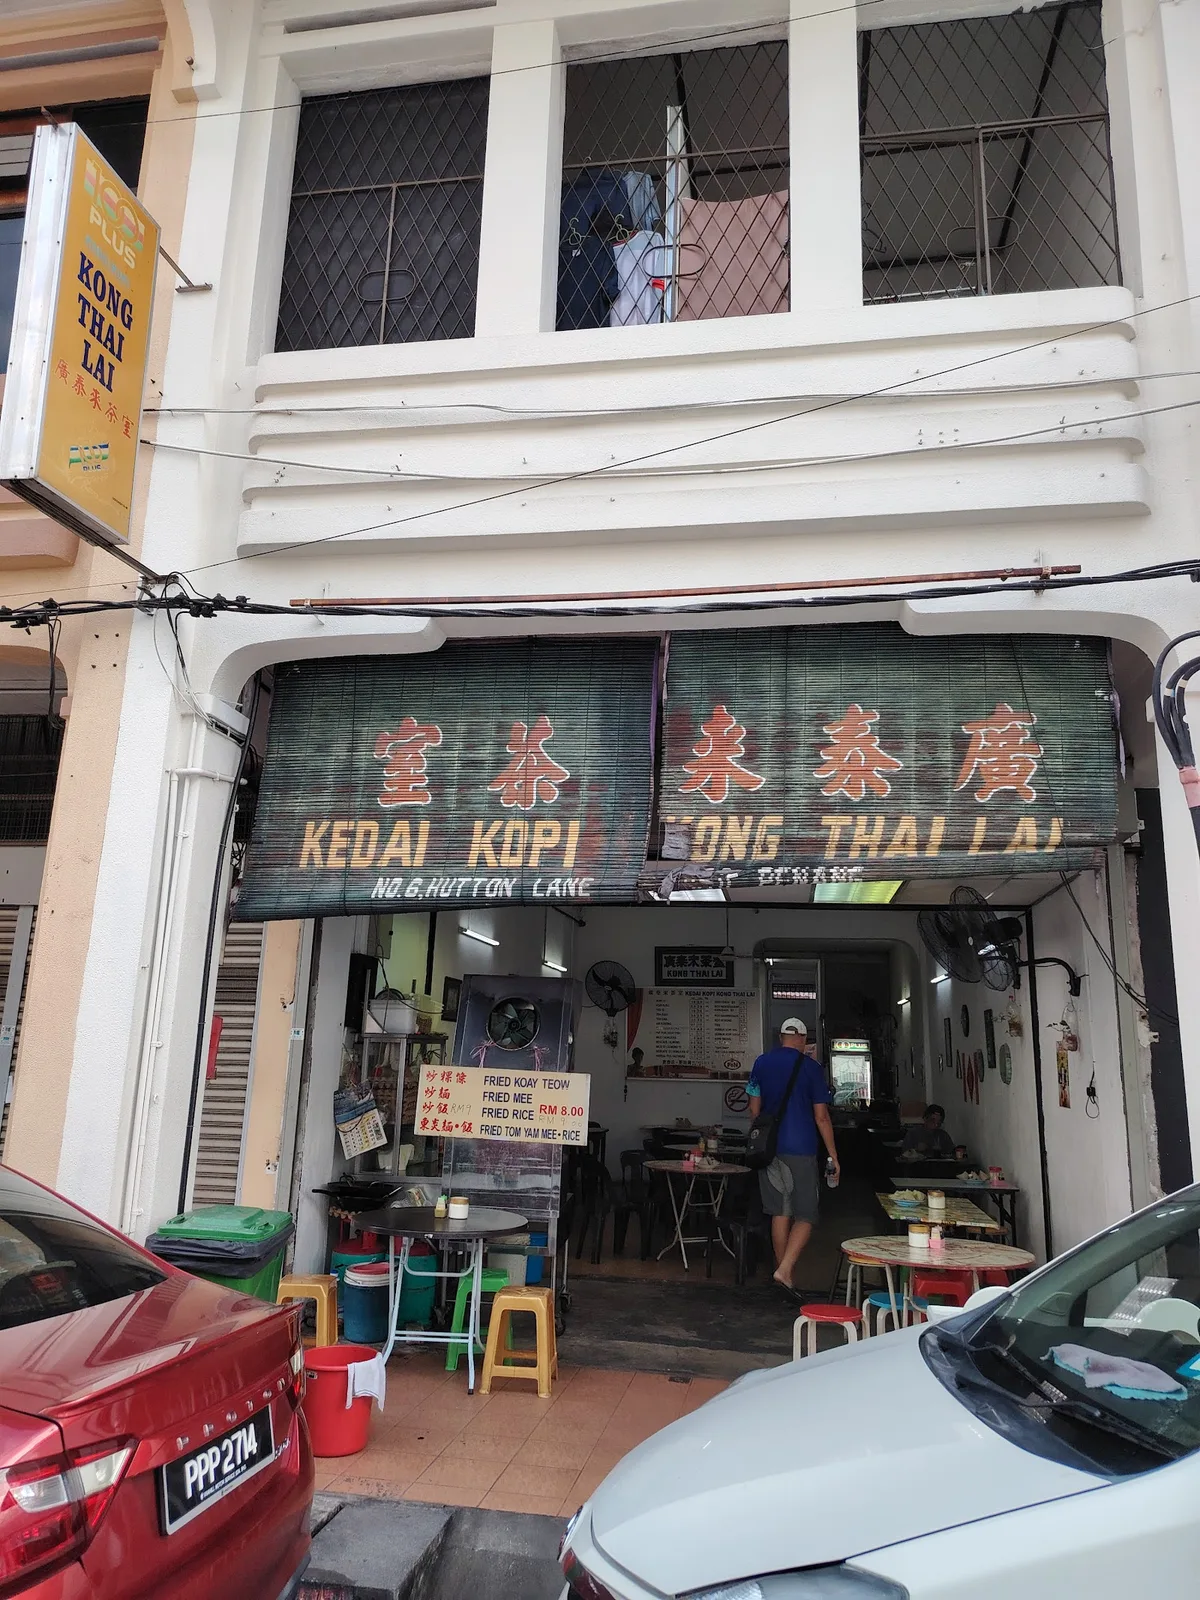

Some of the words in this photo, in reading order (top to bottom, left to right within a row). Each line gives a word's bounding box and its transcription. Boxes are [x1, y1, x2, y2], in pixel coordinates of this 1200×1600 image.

[89, 204, 136, 269] PLUS
[78, 251, 133, 331] KONG
[78, 293, 125, 363] THAI
[81, 339, 115, 393] LAI
[299, 819, 430, 868] KEDAI
[467, 819, 580, 868] KOPI
[660, 815, 784, 861] ONG
[821, 815, 945, 859] THAI
[967, 816, 1064, 855] LAI
[532, 877, 595, 898] LANE
[667, 970, 688, 978] KONG
[690, 970, 710, 978] THAI
[711, 970, 723, 978] LAI
[482, 1091, 510, 1103] FRIED
[513, 1093, 533, 1104] MEE
[483, 1075, 511, 1088] FRIED
[514, 1077, 538, 1089] KOAY
[542, 1078, 570, 1091] TEOW
[481, 1107, 510, 1119] FRIED
[512, 1109, 535, 1121] RICE
[539, 1104, 558, 1115] RM
[560, 1106, 584, 1117] 8.00
[479, 1124, 503, 1136] FRIED
[505, 1126, 522, 1137] TOM
[523, 1127, 540, 1139] YAM
[184, 1445, 221, 1500] PPP
[222, 1422, 258, 1475] 2714
